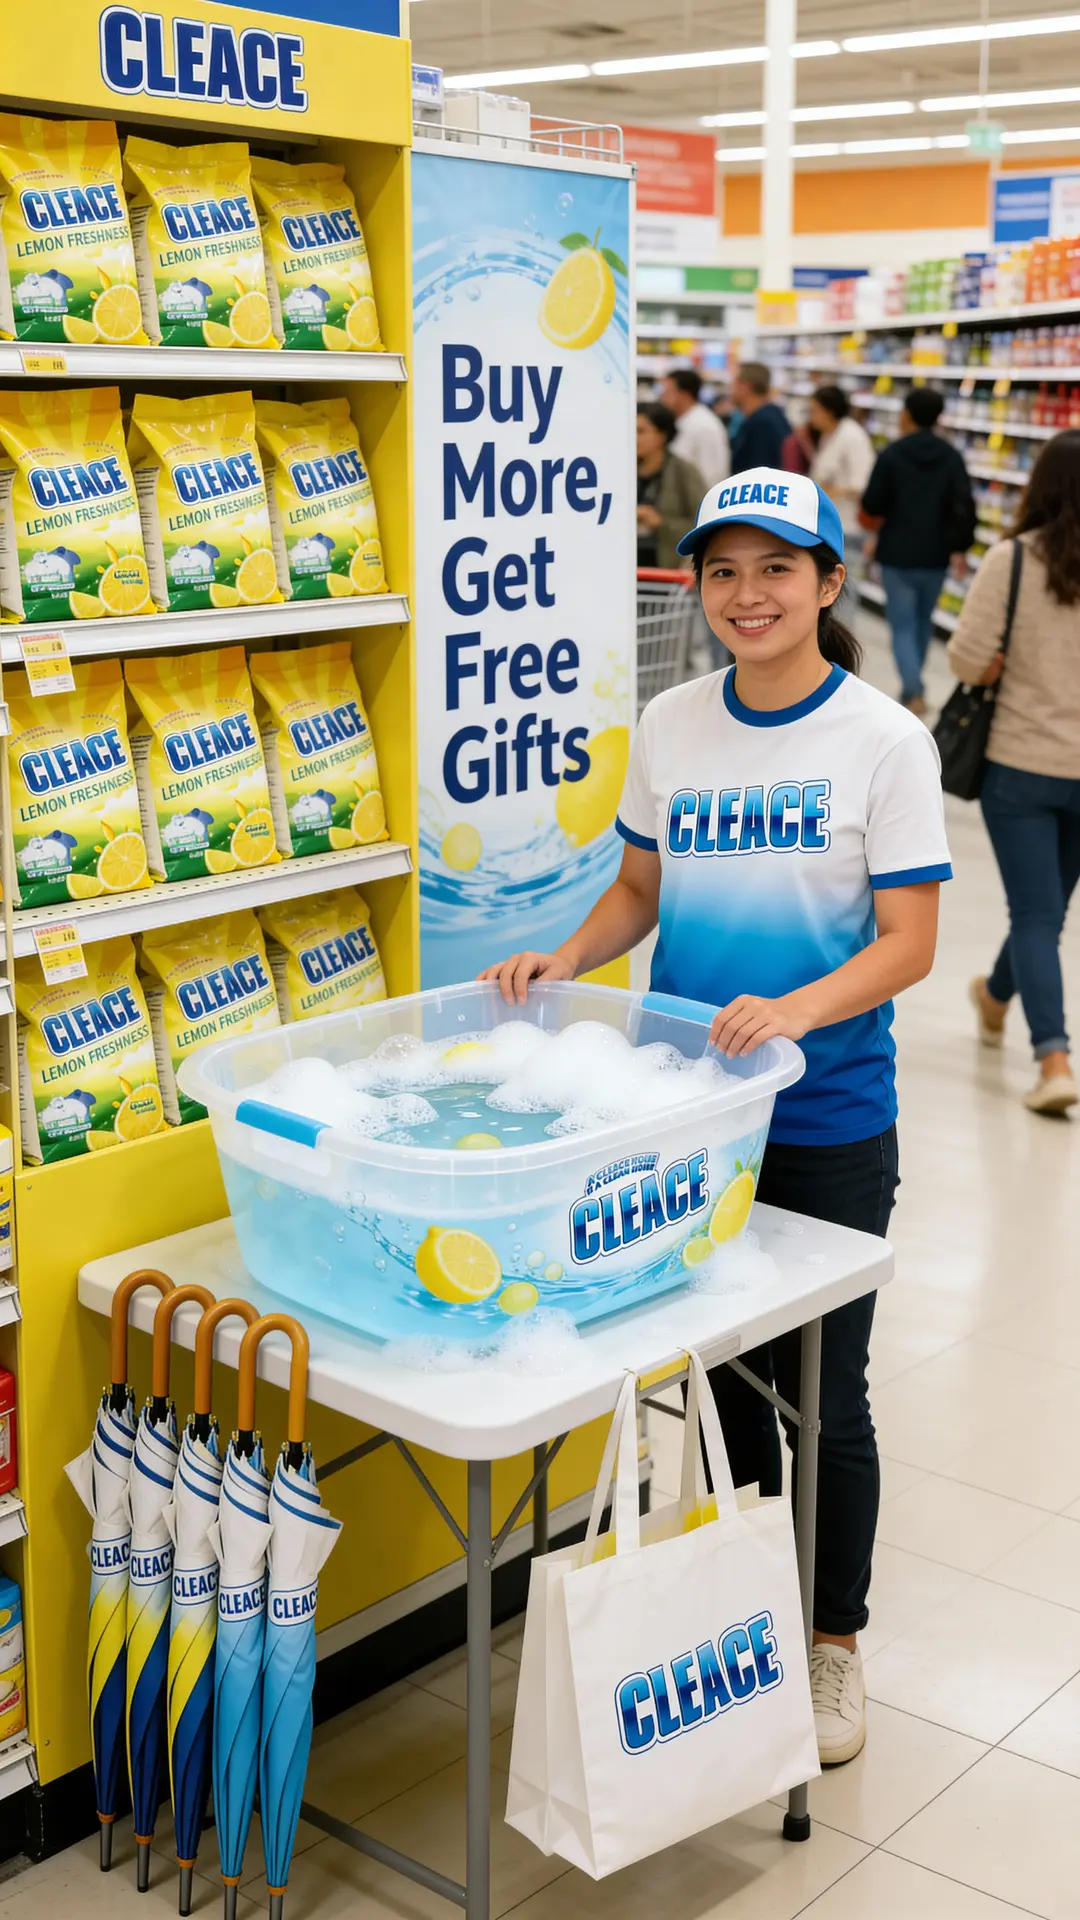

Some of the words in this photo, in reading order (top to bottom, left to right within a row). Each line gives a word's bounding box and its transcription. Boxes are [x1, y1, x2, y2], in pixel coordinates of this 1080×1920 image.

[103, 9, 305, 108] CLEACE
[23, 186, 123, 229] CLEACE
[164, 198, 256, 242] CLEACE
[283, 211, 361, 250] CLEACE
[17, 236, 63, 257] LEMON
[68, 225, 129, 249] FRESHNESS
[160, 245, 202, 267] LEMON
[205, 236, 262, 260] FRESHNESS
[283, 255, 322, 274] LEMON
[442, 344, 563, 444] Buy
[31, 457, 127, 507] CLEACE
[174, 452, 262, 504] CLEACE
[290, 450, 367, 499] CLEACE
[442, 441, 612, 525] More,
[717, 483, 790, 510] CLEACE
[27, 512, 72, 536] LEMON
[169, 507, 211, 531] LEMON
[289, 501, 326, 524] LEMON
[442, 536, 556, 616] Get
[445, 631, 580, 711] Free
[164, 714, 256, 774] CLEACE
[290, 701, 366, 757] CLEACE
[21, 730, 126, 794] CLEACE
[290, 758, 328, 782] LEMON
[442, 712, 591, 803] Gifts
[20, 794, 67, 822] LEMON
[162, 773, 204, 801] LEMON
[668, 783, 828, 854] CLEACE
[300, 927, 376, 987] CLEACE
[177, 955, 269, 1021] CLEACE
[43, 987, 141, 1056] CLEACE
[177, 1019, 217, 1048] LEMON
[219, 992, 275, 1032] FRESHNESS
[42, 1053, 87, 1084] LEMON
[89, 1024, 150, 1064] FRESHNESS
[572, 1152, 707, 1261] CLEACE
[91, 1542, 130, 1568] CLEAC
[273, 1588, 318, 1619] CLEAC
[620, 1616, 781, 1751] CLEACE
